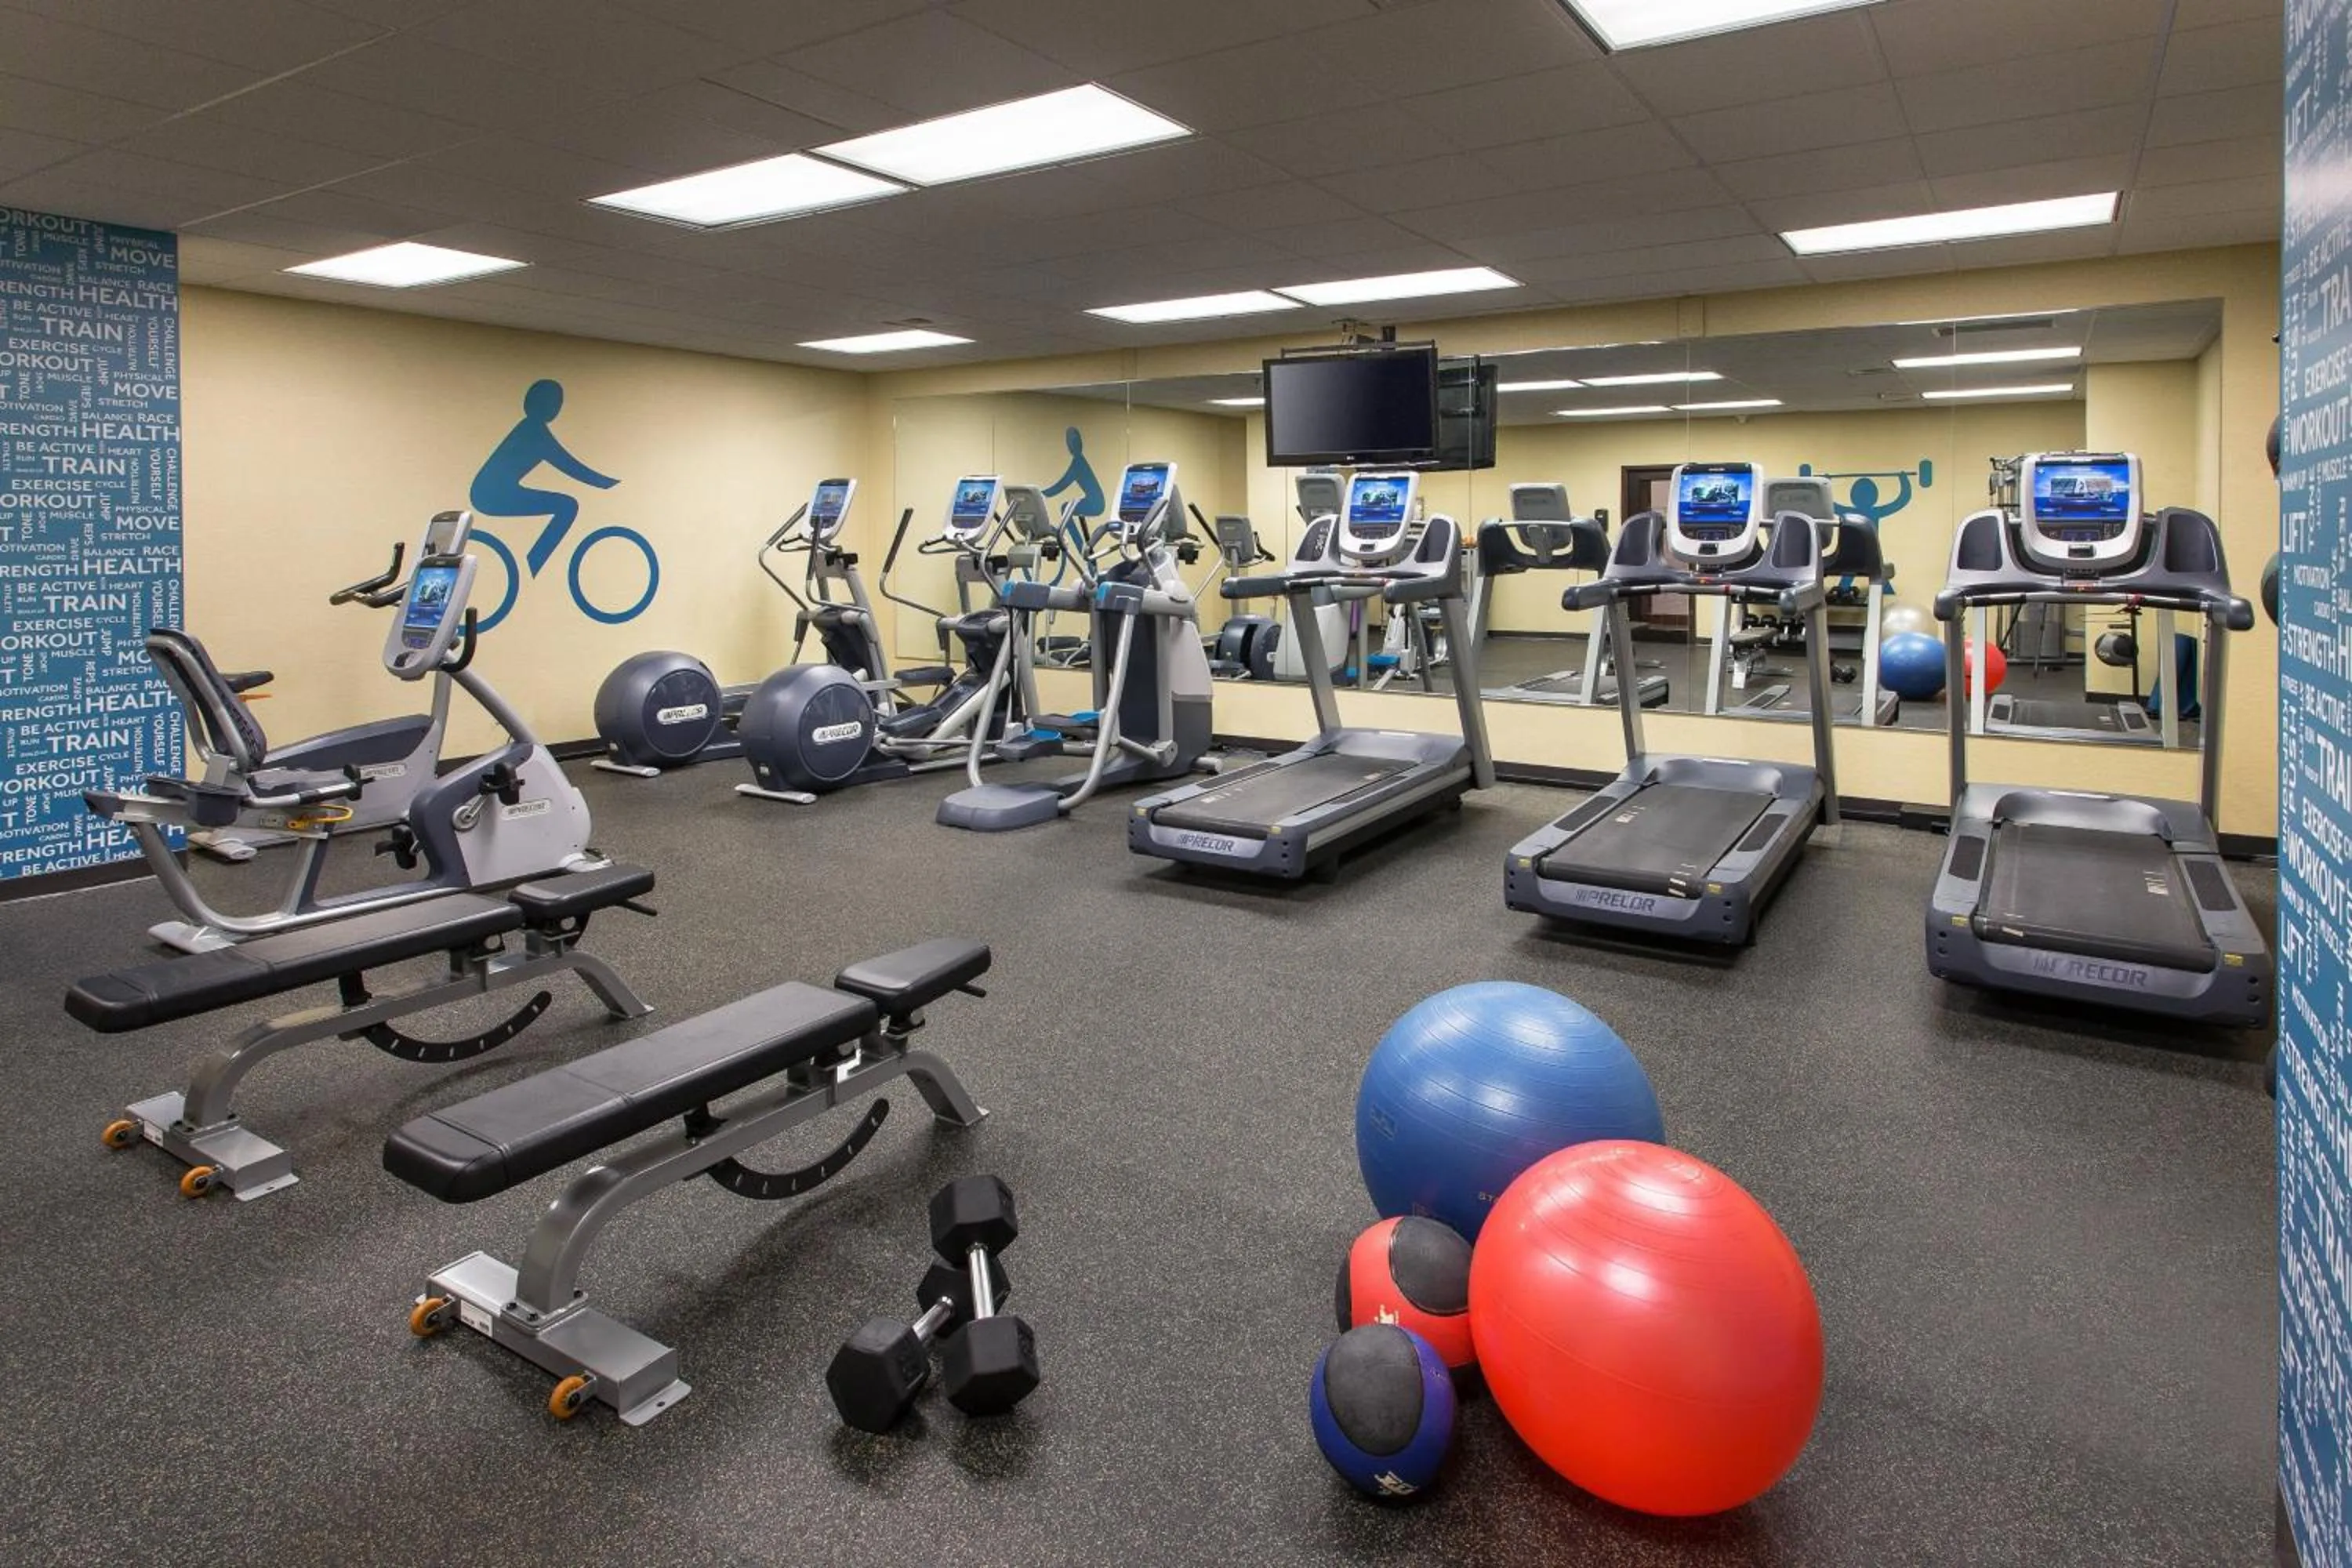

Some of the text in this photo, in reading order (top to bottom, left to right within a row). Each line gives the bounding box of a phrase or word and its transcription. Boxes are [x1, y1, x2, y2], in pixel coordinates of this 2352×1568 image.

[111, 247, 176, 270] MOVE
[137, 279, 175, 294] RACE
[79, 285, 178, 312] HEALTH
[13, 299, 33, 311] BE
[36, 301, 93, 318] ACTIVE
[39, 317, 123, 341] TRAIN
[9, 337, 89, 355] EXERCISE
[164, 317, 176, 380] CHALLENGE
[0, 351, 94, 372] ORKOUT
[2305, 347, 2347, 398] EXERCISE
[114, 382, 178, 400] MOVE
[97, 397, 148, 409] STRETCH
[82, 412, 133, 423] BALANCE
[137, 412, 175, 424] RACE
[2290, 396, 2349, 457] WORKOUT
[82, 421, 180, 443] HEALTH
[16, 441, 96, 455] BE ACTIVE
[42, 456, 126, 476] TRAIN
[150, 448, 162, 501] YOURSELF
[12, 480, 93, 492] EXERCISE
[166, 448, 178, 511] CHALLENGE
[0, 494, 96, 509] ORKOUT
[115, 506, 167, 514] PHYSICAL
[50, 511, 95, 520] MUSCLE
[117, 516, 180, 531] MOVE
[100, 532, 151, 542] STRETCH
[2282, 512, 2306, 554] LIFT
[83, 548, 136, 557] BALANCE
[143, 545, 178, 557] RACE
[0, 563, 78, 578] RENGTH
[83, 557, 182, 576] HEALTH
[17, 581, 97, 594] BE ACTIVE
[109, 581, 144, 590] HEART
[43, 593, 126, 614] TRAIN
[152, 579, 163, 628] YOURSEL
[169, 579, 180, 629] CHALLEN
[13, 617, 94, 633] EXERCISE
[1, 631, 98, 651] ORKOUT
[101, 628, 112, 657] JUMP
[118, 639, 145, 648] PHYS
[2287, 622, 2336, 675] STRENGTH
[51, 648, 96, 658] MUSCLE
[118, 649, 151, 666] MO
[22, 652, 34, 683] TONE
[102, 666, 153, 677] STRETCH
[86, 683, 138, 695] BALANCE
[2, 702, 81, 722] RENGTH
[2305, 683, 2314, 716] BE
[2315, 690, 2346, 735] ACTIVE
[21, 724, 39, 736] BE
[44, 718, 99, 735] ACTIVE
[113, 716, 147, 726] HEART
[47, 728, 129, 754] TRAIN
[170, 711, 181, 774] CHALLENGE
[99, 751, 129, 760] CYCLE
[16, 756, 96, 775] EXERCISE
[0, 769, 100, 794] ORKOUT
[3, 798, 18, 807] UP
[26, 795, 37, 824] TONE
[2303, 797, 2343, 866] EXERCISE
[23, 852, 100, 876] BE ACTIVE
[2287, 826, 2345, 926] WORKOUT
[2281, 910, 2304, 977] LIFT
[2285, 1033, 2335, 1151] STRENGTH
[2287, 1236, 2344, 1414] WORKOUT
